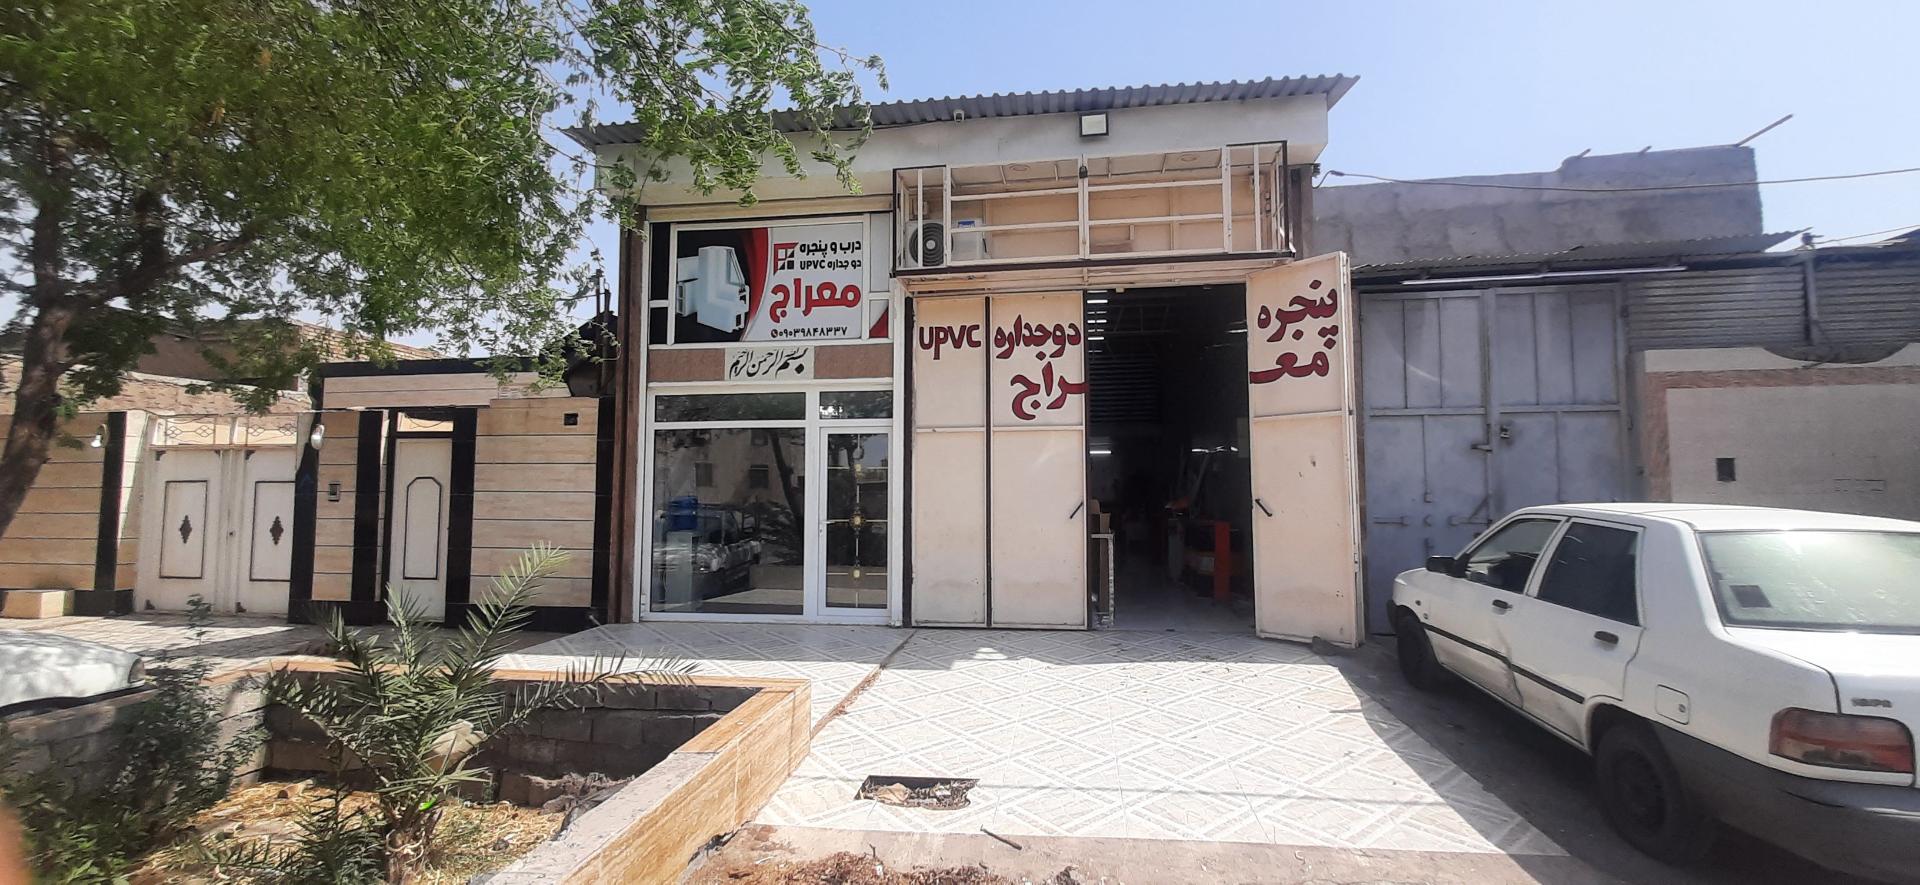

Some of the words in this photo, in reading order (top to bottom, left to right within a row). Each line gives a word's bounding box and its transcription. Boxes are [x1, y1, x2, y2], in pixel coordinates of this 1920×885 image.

[799, 240, 828, 258] پنجره
[830, 241, 837, 254] و
[840, 240, 862, 254] درب
[799, 259, 826, 270] UPVC
[827, 259, 849, 271] جداره
[850, 259, 862, 269] دو
[769, 277, 862, 324] معراج
[1257, 279, 1339, 350] پنجره
[778, 326, 848, 338] ۰۹۰۳۹۸۴۸۳۳۷
[919, 324, 982, 361] UPVC
